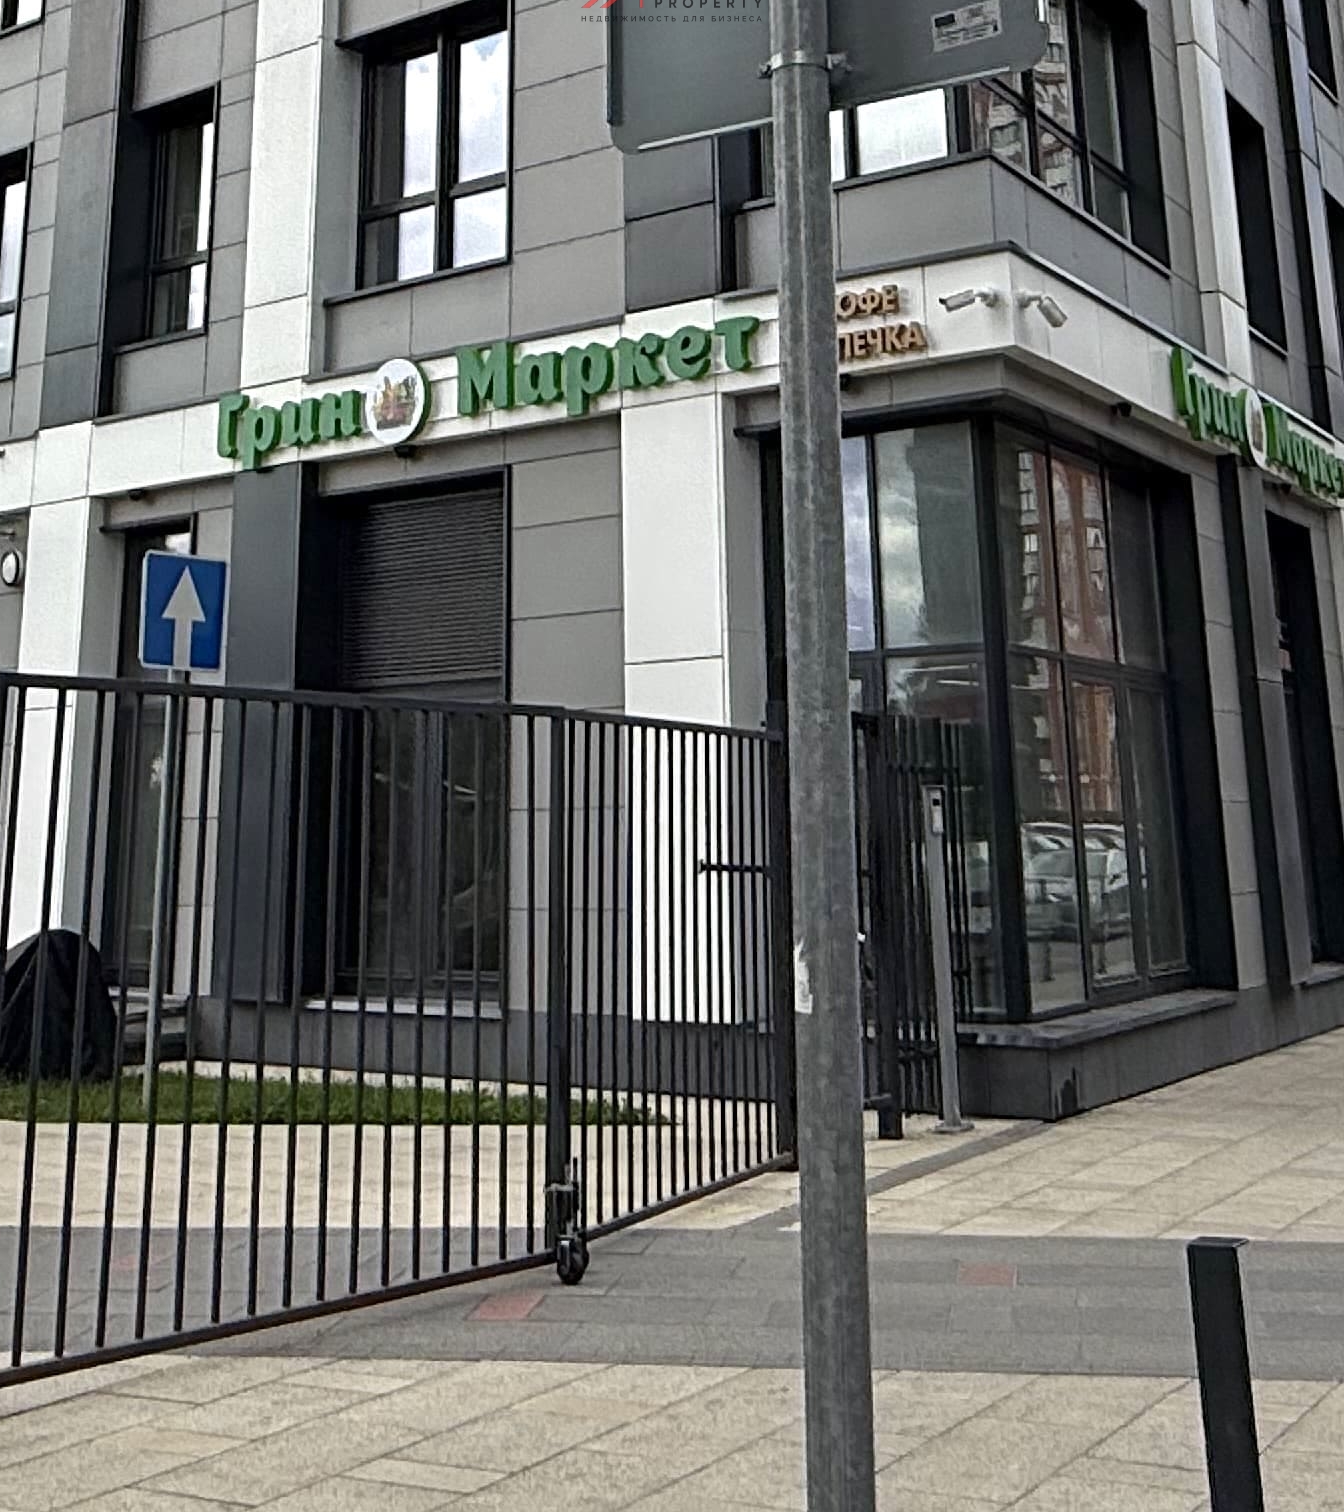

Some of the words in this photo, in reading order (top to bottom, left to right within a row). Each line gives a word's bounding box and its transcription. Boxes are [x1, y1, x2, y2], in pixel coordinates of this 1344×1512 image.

[836, 285, 901, 321] ОФЕ
[838, 321, 928, 363] ПЕЧКА
[217, 391, 364, 471] Грин
[455, 315, 760, 418] Маркет
[1170, 345, 1247, 442] Грин
